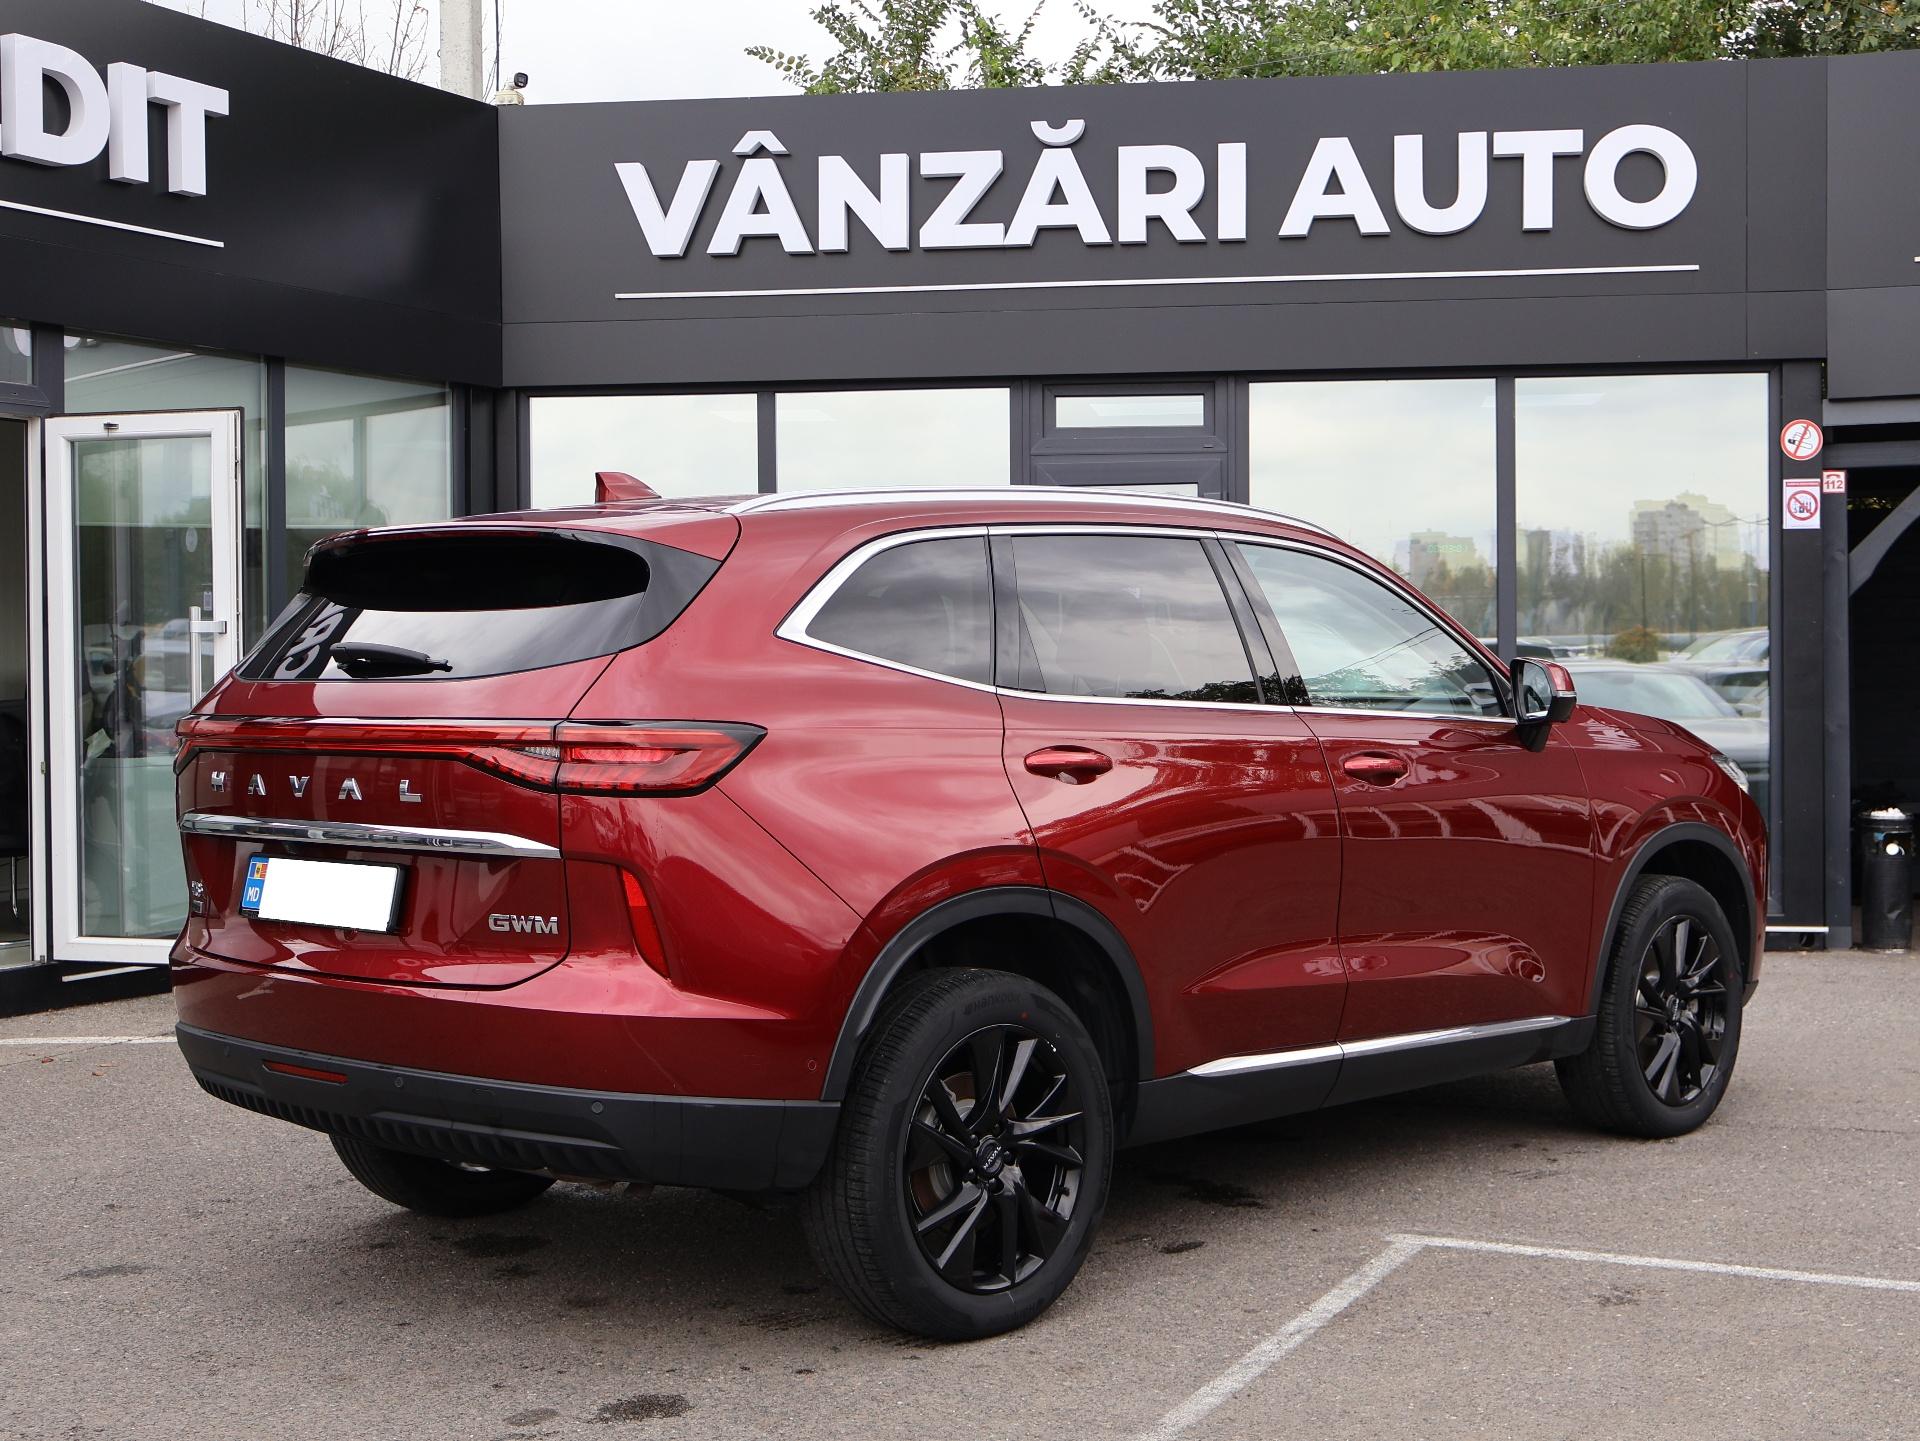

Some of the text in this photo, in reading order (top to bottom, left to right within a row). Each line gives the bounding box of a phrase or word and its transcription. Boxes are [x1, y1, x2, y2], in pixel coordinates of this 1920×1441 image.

[0, 32, 229, 197] DIT
[614, 119, 1698, 257] VÂNZĂRI AUTO
[1824, 479, 1843, 489] 112
[211, 771, 423, 802] HAVAL
[247, 887, 260, 902] MD
[488, 913, 559, 935] GWM
